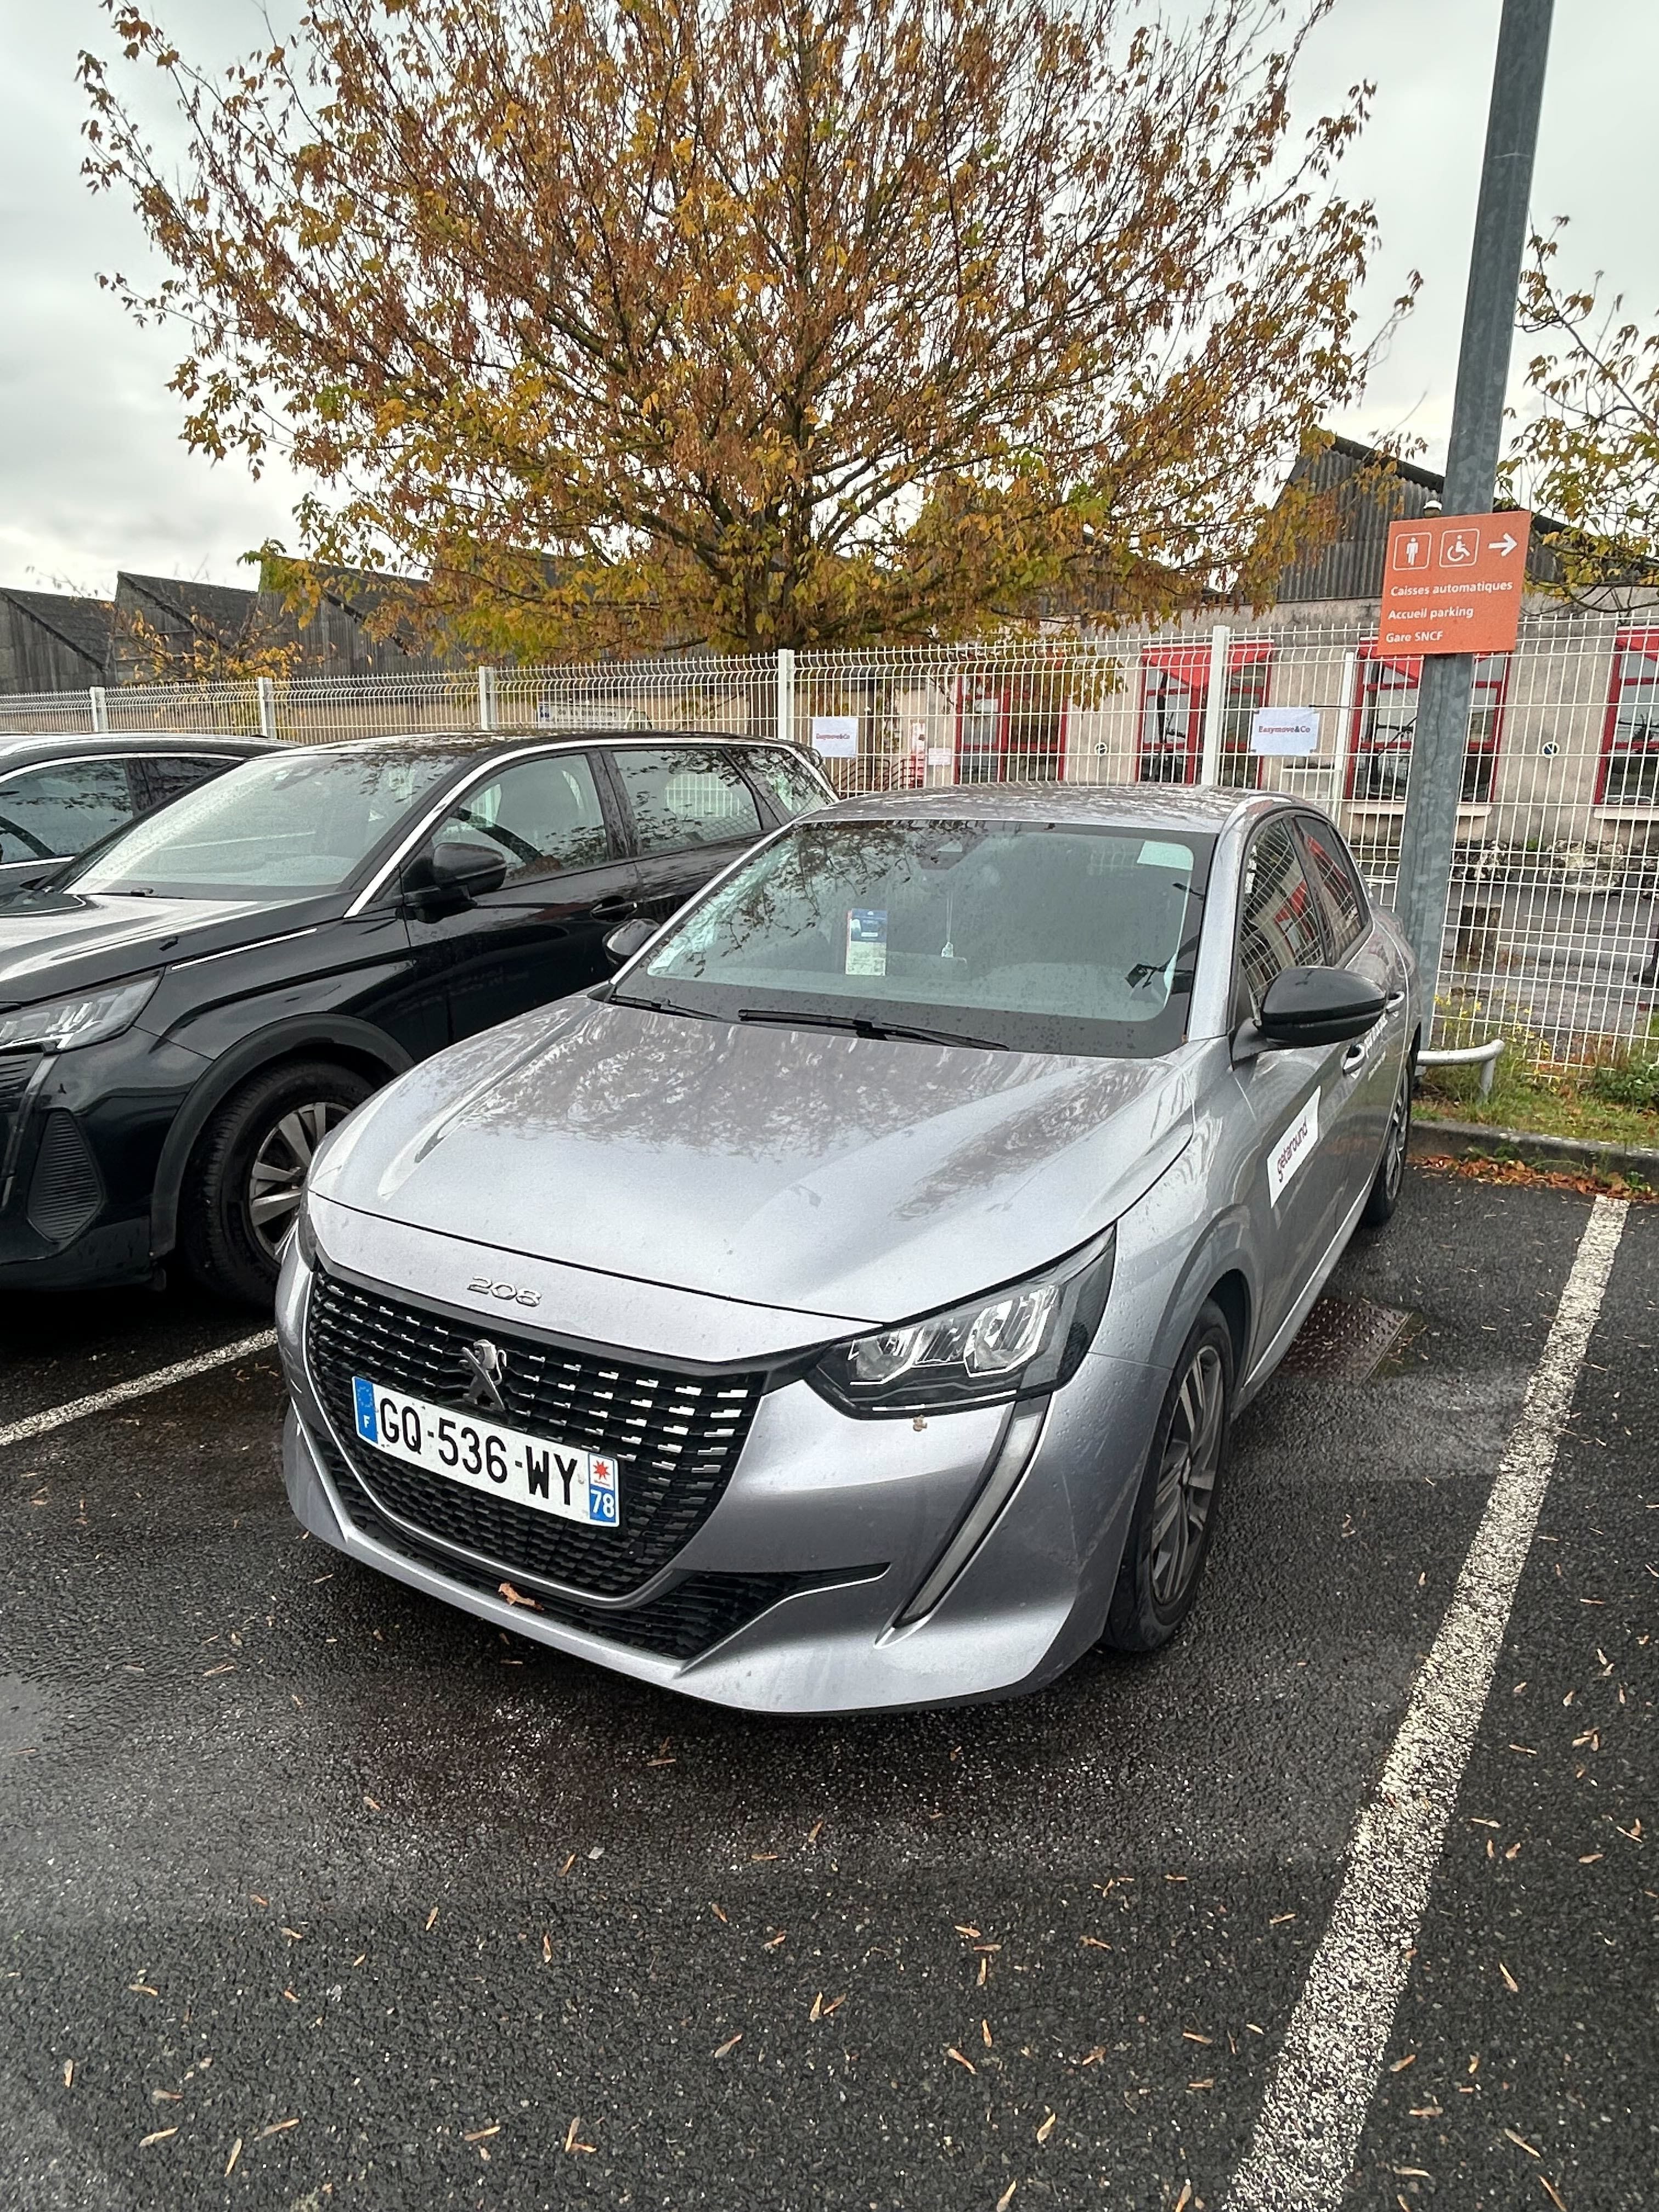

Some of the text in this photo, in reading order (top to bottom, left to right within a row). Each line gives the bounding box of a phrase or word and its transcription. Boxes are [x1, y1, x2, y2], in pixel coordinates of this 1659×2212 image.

[1390, 581, 1514, 597] Caisses automatiques
[1387, 606, 1474, 620] Accueil parking
[1385, 630, 1444, 643] Gare SNCF
[1277, 1115, 1308, 1183] getaround
[467, 1276, 543, 1307] 208
[363, 1397, 615, 1518] F GQ-536-WY 78
